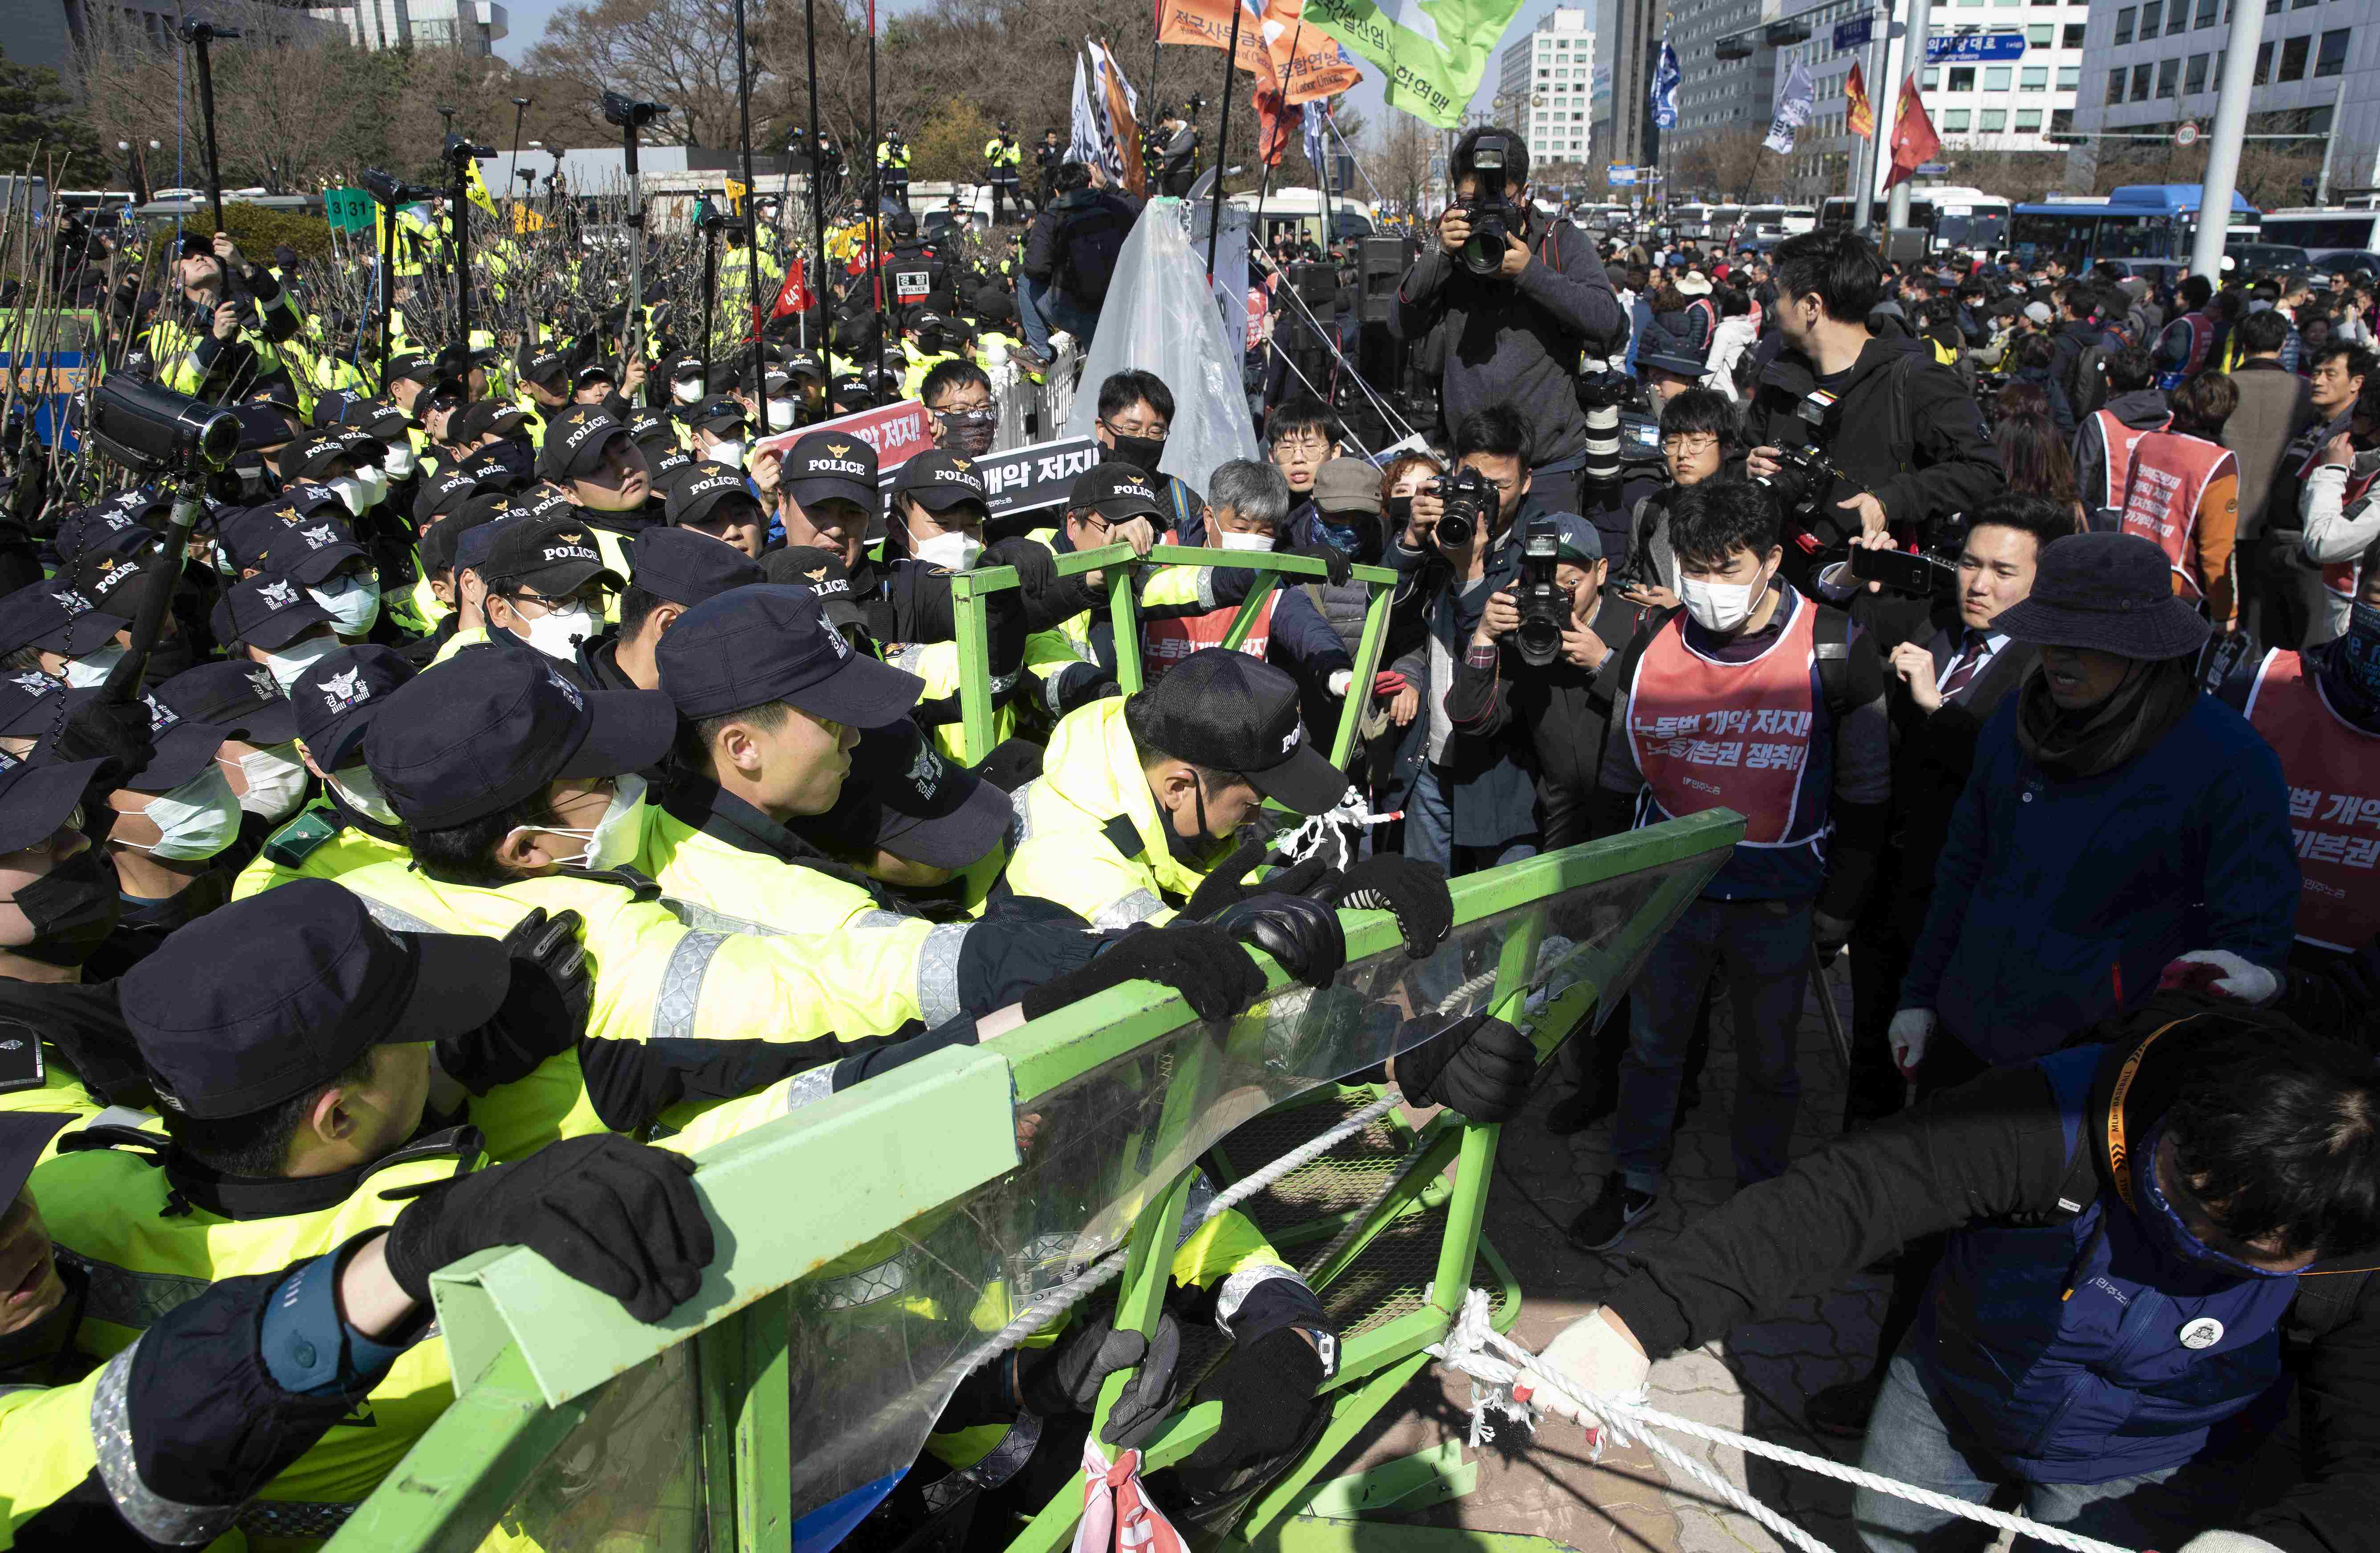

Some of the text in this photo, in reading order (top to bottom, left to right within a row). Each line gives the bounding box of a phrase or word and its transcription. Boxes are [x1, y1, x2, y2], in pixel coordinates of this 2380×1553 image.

[2180, 130, 2194, 140] 60
[899, 275, 926, 286] 경찰
[532, 353, 557, 367] POLICE
[677, 359, 702, 368] POLICE
[789, 358, 813, 367] POLICE
[566, 415, 610, 449] POLICE
[305, 441, 344, 460] POLICE
[808, 459, 865, 476] POLICE
[689, 476, 741, 496] POLICE
[935, 470, 982, 492] POLICE
[1113, 484, 1155, 502] POLICE
[988, 497, 1013, 508] 민주노총
[542, 546, 600, 562] POLICE
[95, 561, 141, 594] POLICE
[324, 679, 370, 714] 경찰
[1634, 709, 1813, 739] 노동법 개악 저지!
[1646, 737, 1744, 768] 노동기본권
[1692, 779, 1721, 796] 민주노총
[2111, 1070, 2132, 1133] MLB BASEBALL
